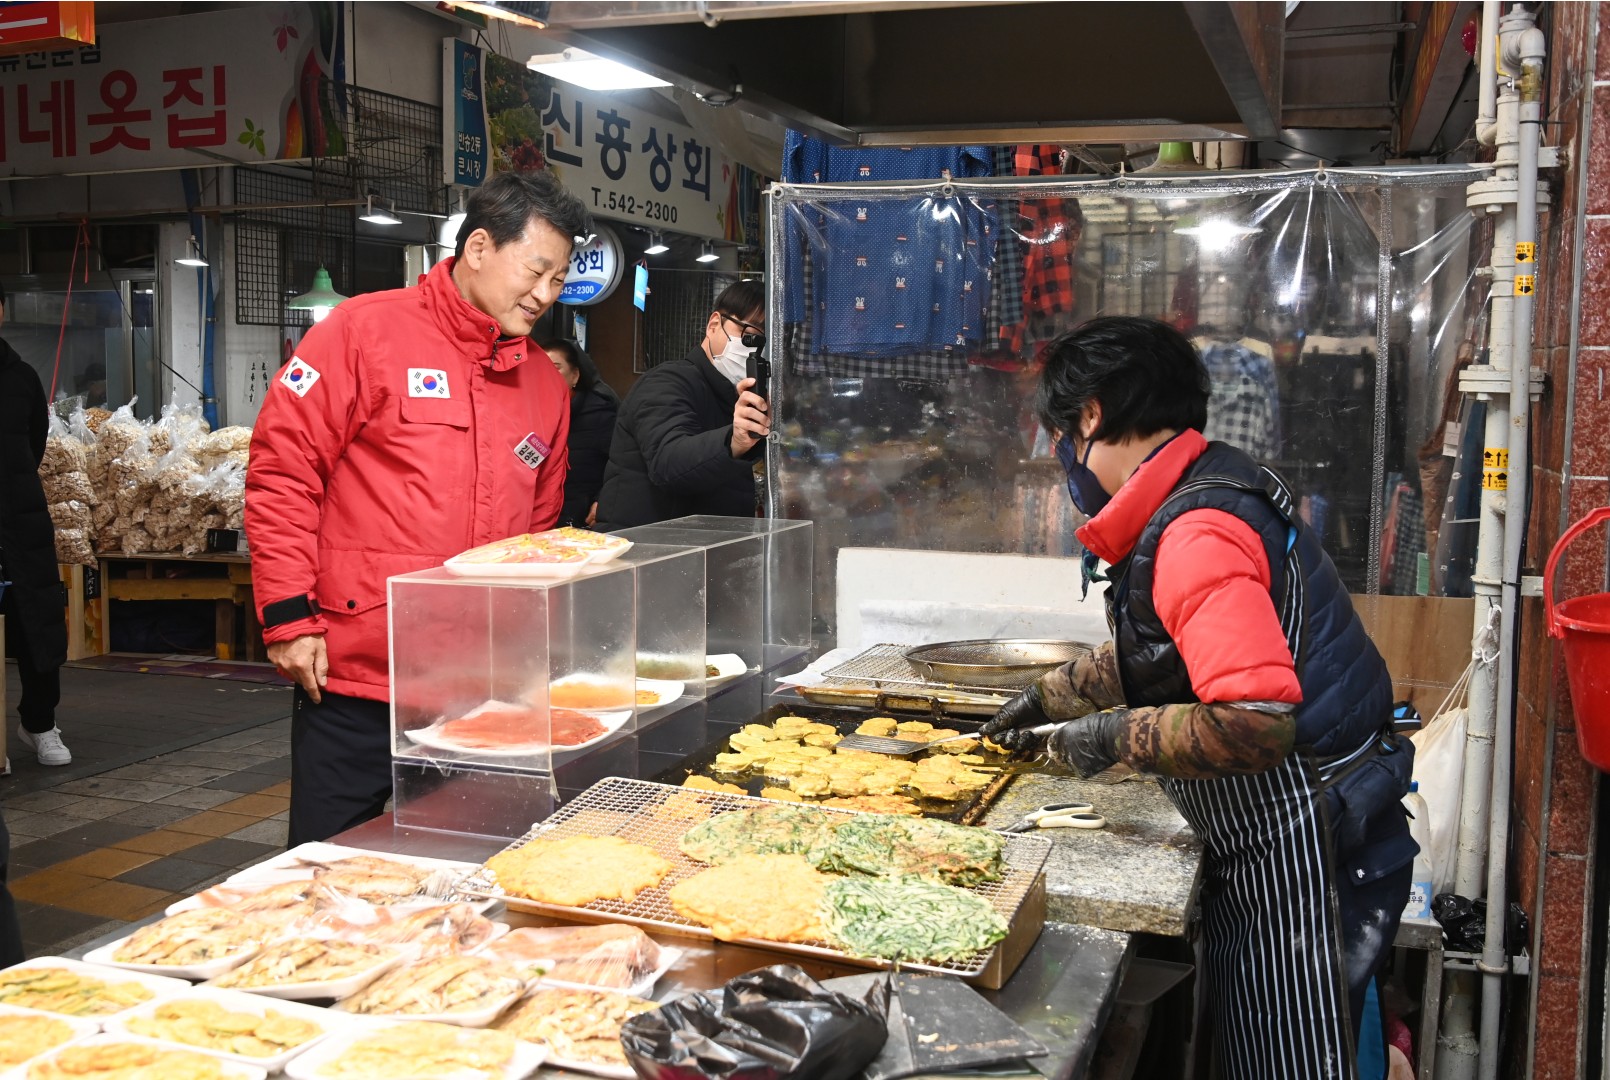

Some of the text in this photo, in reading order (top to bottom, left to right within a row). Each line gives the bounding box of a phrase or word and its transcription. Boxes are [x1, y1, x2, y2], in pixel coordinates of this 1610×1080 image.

[0, 65, 226, 162] 네옷집
[458, 131, 481, 156] 반송2동
[542, 92, 711, 202] 신흥상회
[591, 186, 678, 223] T.542-2300
[569, 249, 604, 275] 상회
